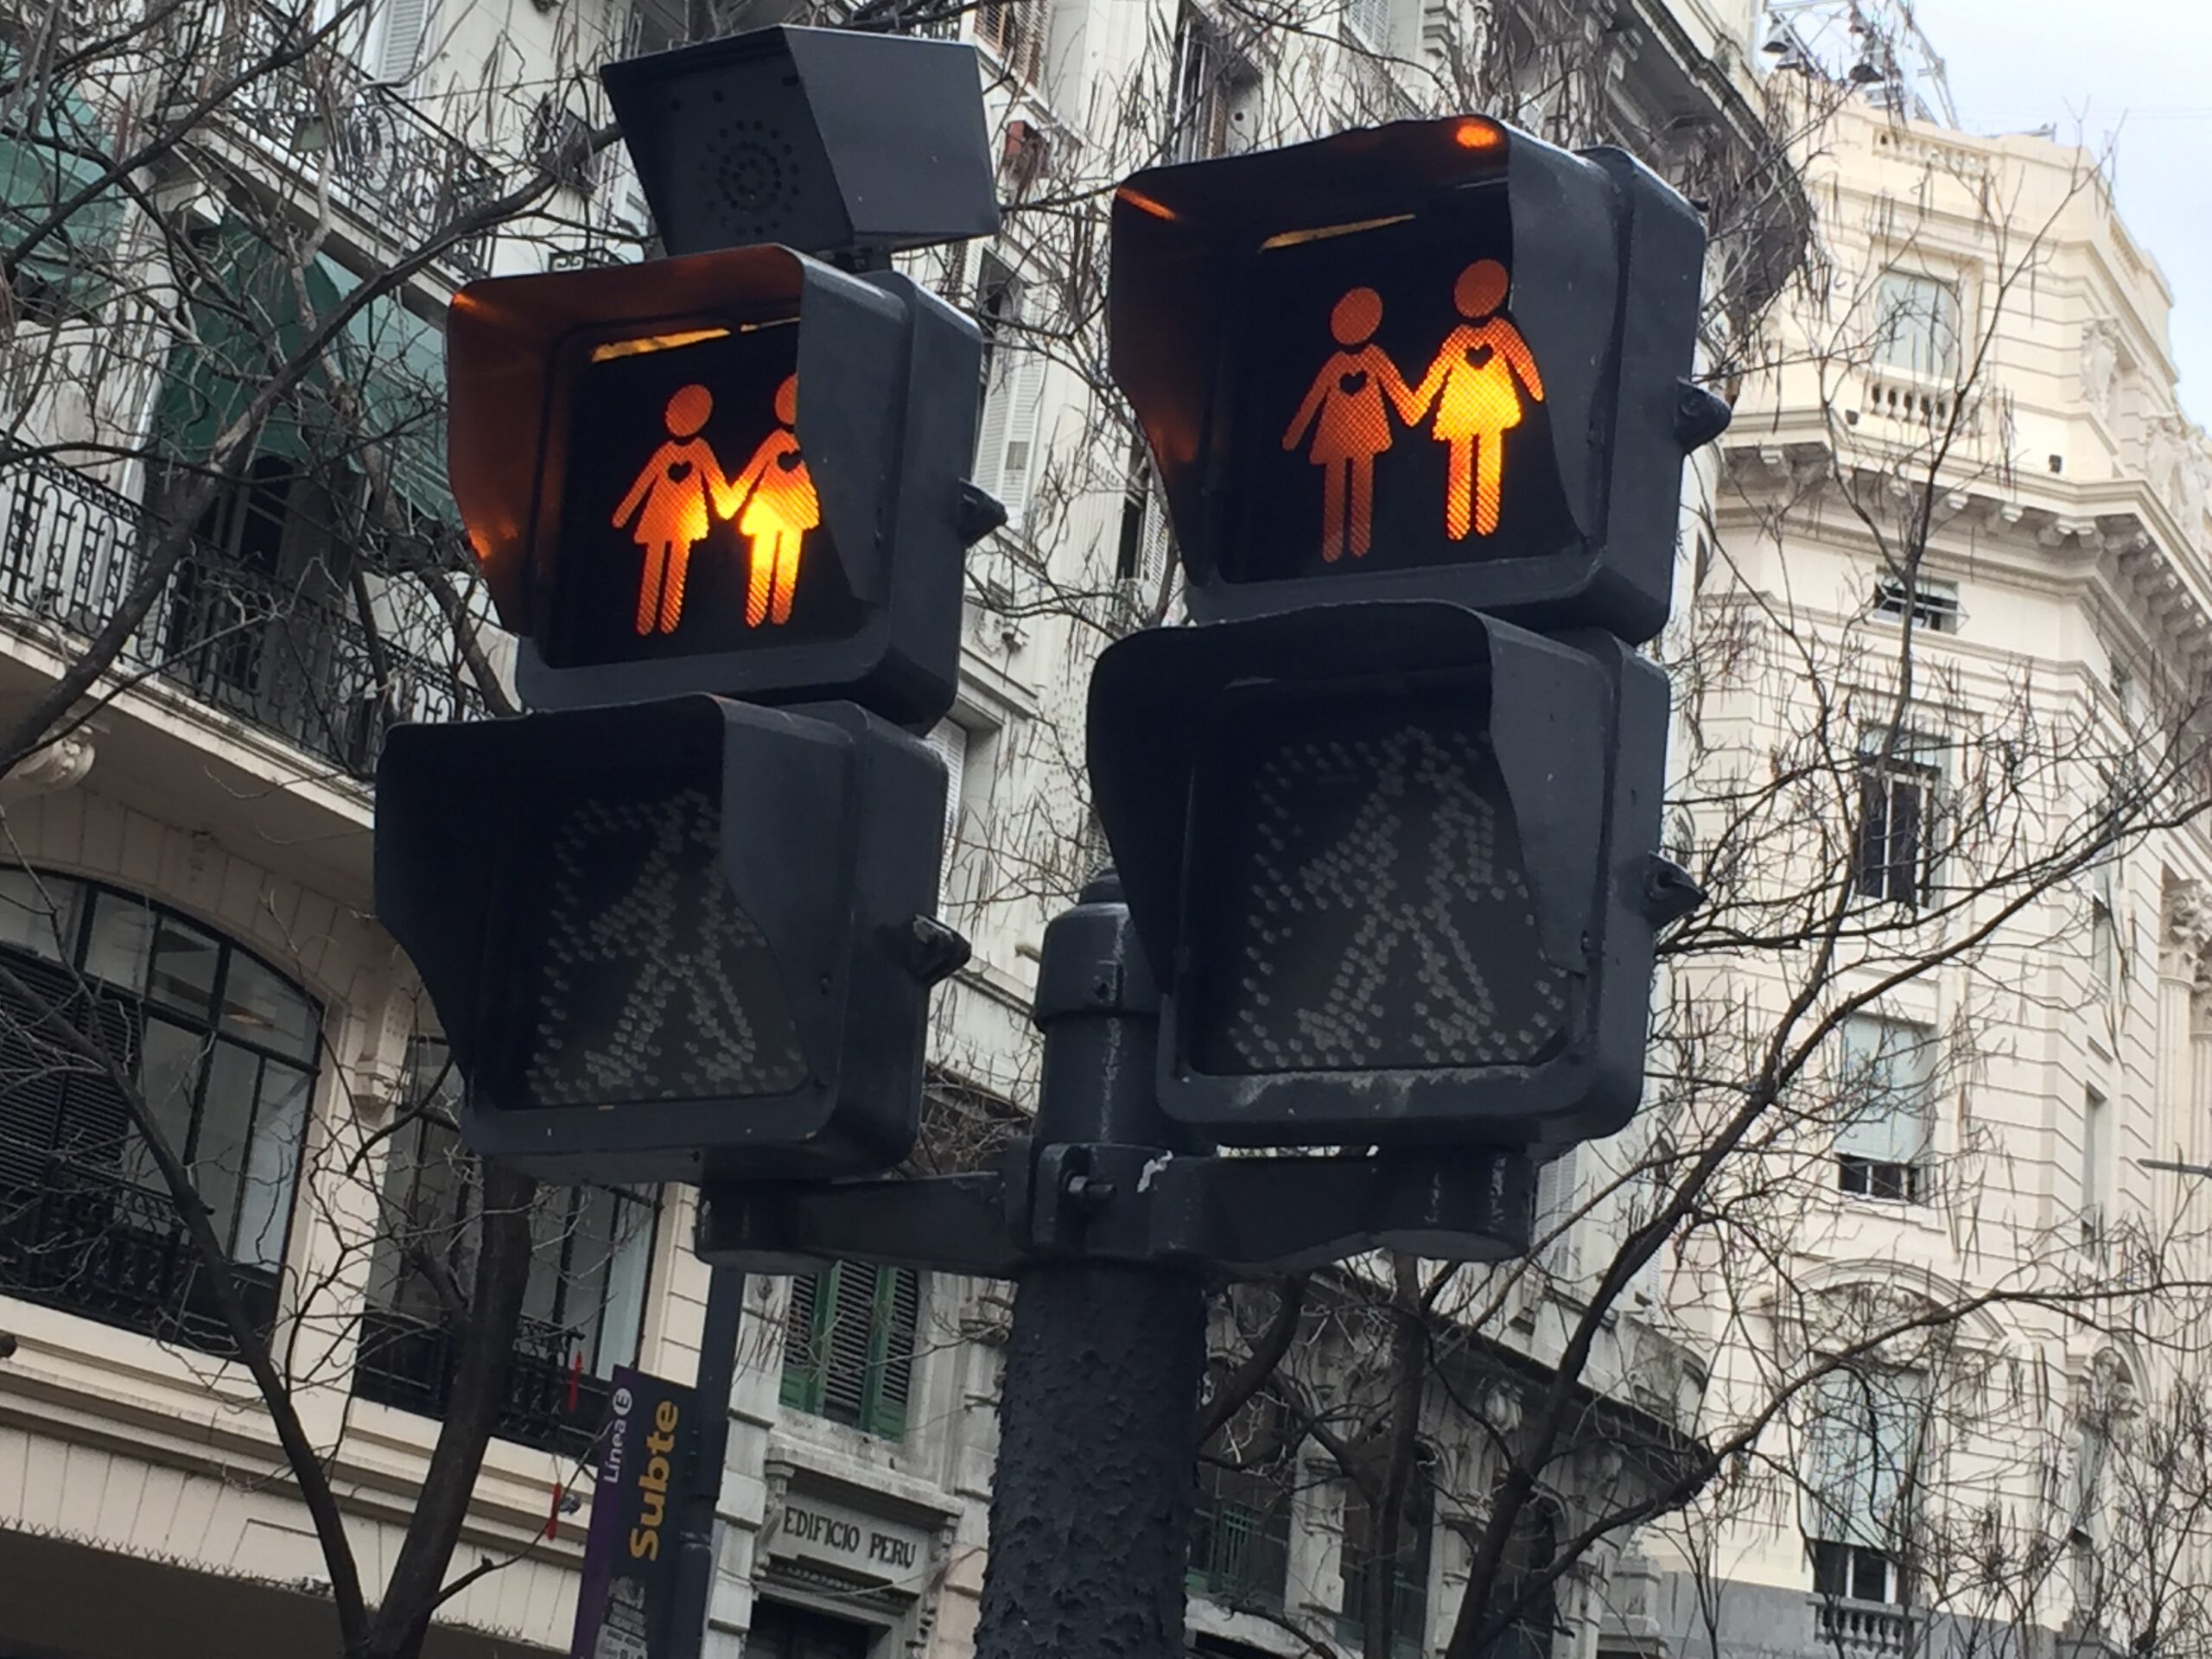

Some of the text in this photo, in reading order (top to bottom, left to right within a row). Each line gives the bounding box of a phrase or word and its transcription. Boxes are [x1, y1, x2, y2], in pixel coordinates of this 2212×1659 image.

[629, 1400, 679, 1561] Subte
[783, 1506, 917, 1569] EDIFICIO PERU
